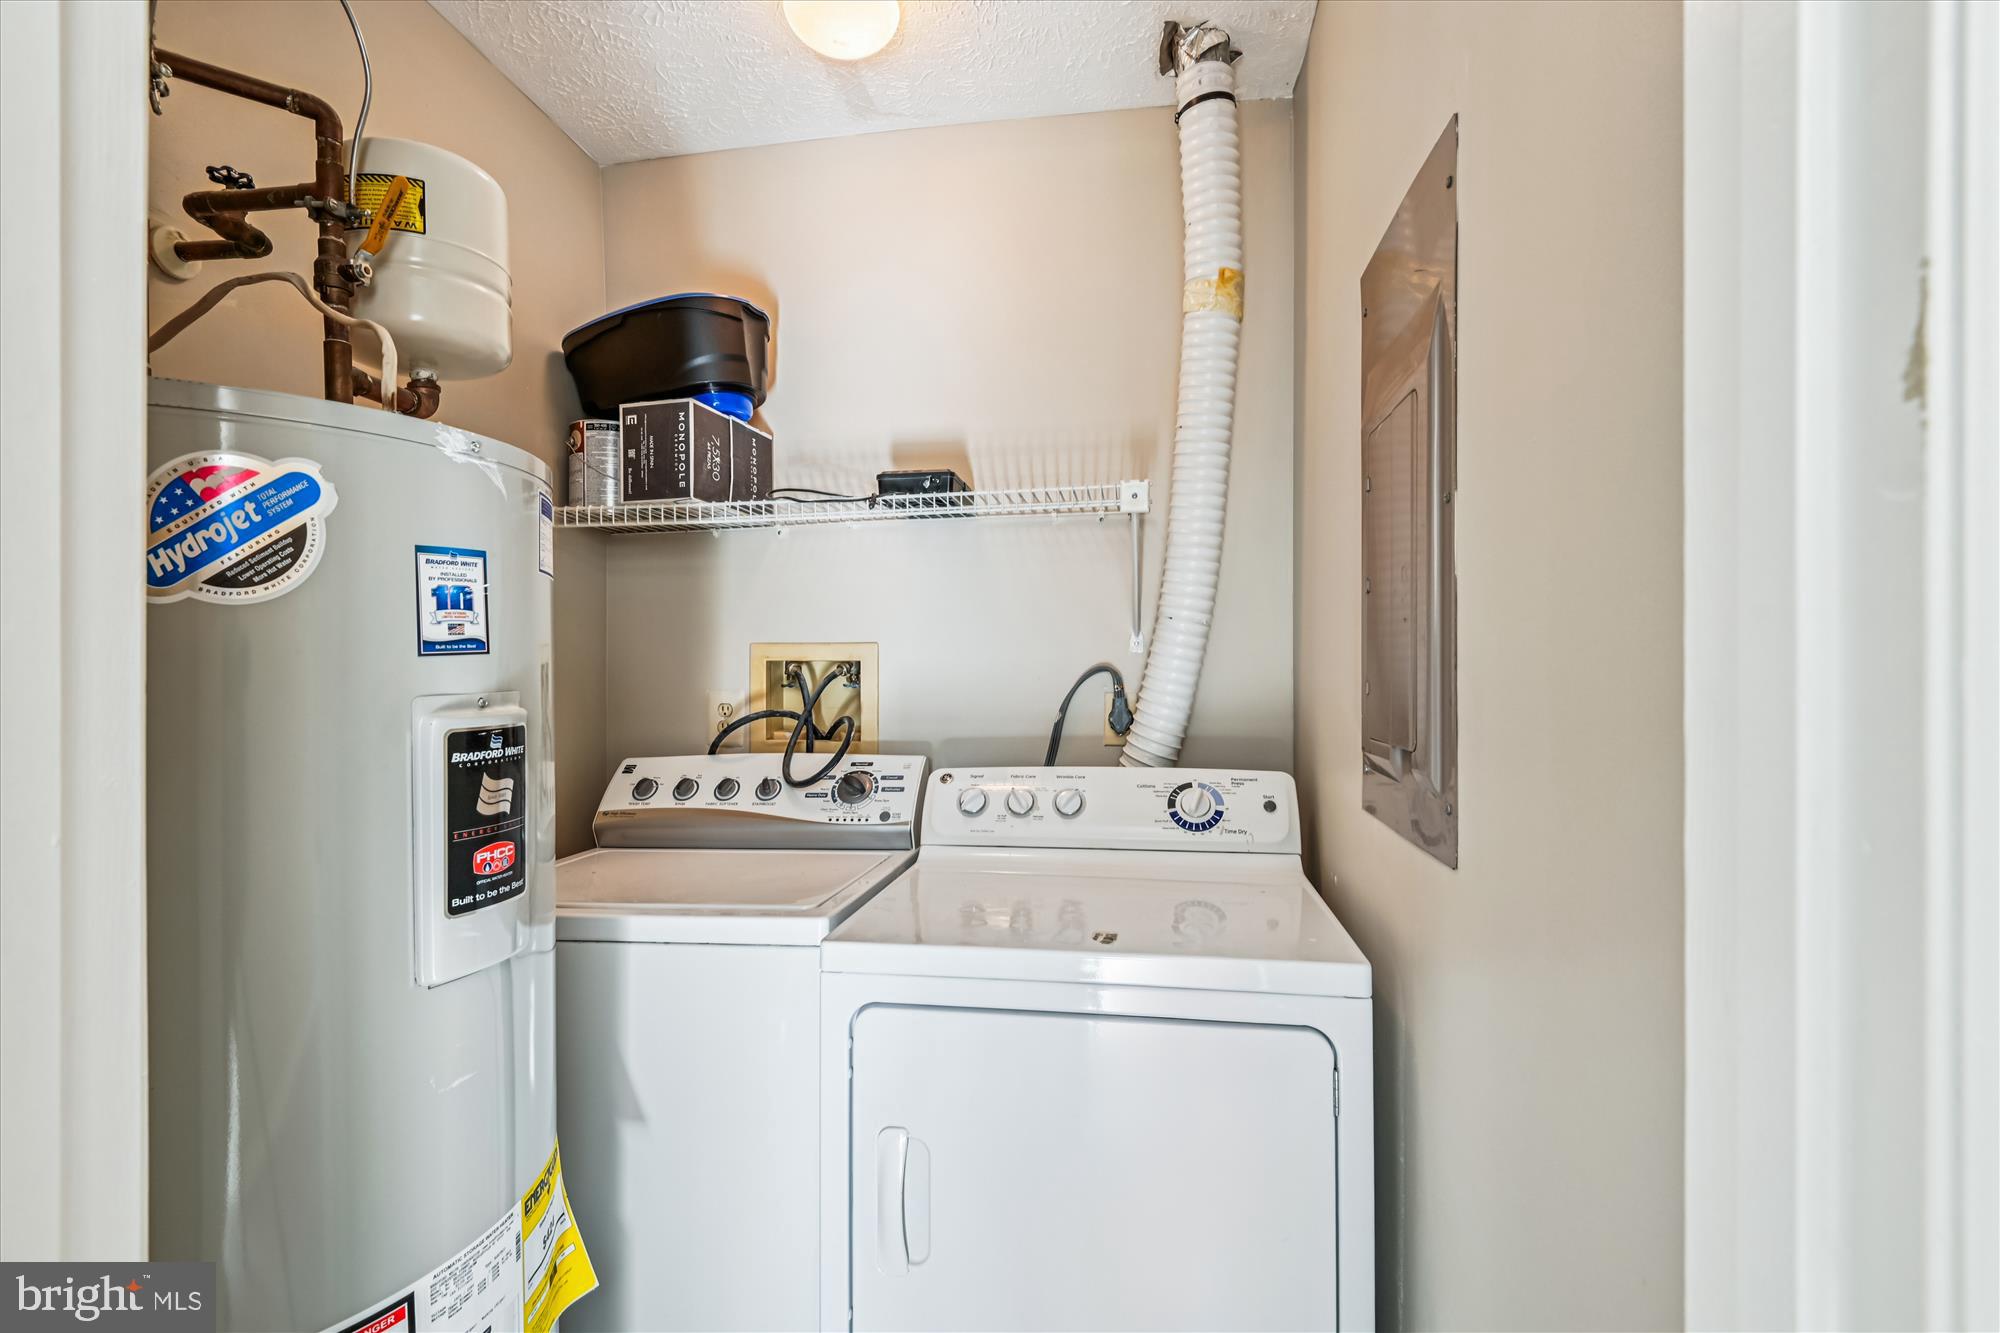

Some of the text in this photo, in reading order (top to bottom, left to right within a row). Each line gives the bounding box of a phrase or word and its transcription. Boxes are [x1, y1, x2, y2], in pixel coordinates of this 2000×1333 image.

[678, 411, 686, 488] MONOPOLE
[147, 481, 161, 498] ADE
[167, 468, 178, 476] IN
[257, 488, 277, 500] TOTAL
[262, 480, 309, 509] PERFORMANCE
[166, 482, 256, 533] EQUIPPED WITH
[267, 498, 294, 516] SYSTEM
[148, 500, 262, 578] Hydrojet
[220, 530, 280, 565] FEATURING
[198, 517, 317, 597] BRADFORD WHITE CORPORATION
[226, 561, 250, 577] Reduced
[238, 547, 294, 581] Lower Operating Costs
[253, 558, 292, 582] More Hot Water
[425, 558, 459, 566] BRADFORD
[451, 745, 524, 763] BRADFORD WHITE
[476, 845, 514, 864] PHCC
[452, 879, 524, 907] Built to be the Best
[432, 1255, 462, 1280] AUTOMATIC
[463, 1238, 485, 1258] STORAGE
[485, 1226, 499, 1240] WATER
[500, 1211, 514, 1228] HEATER
